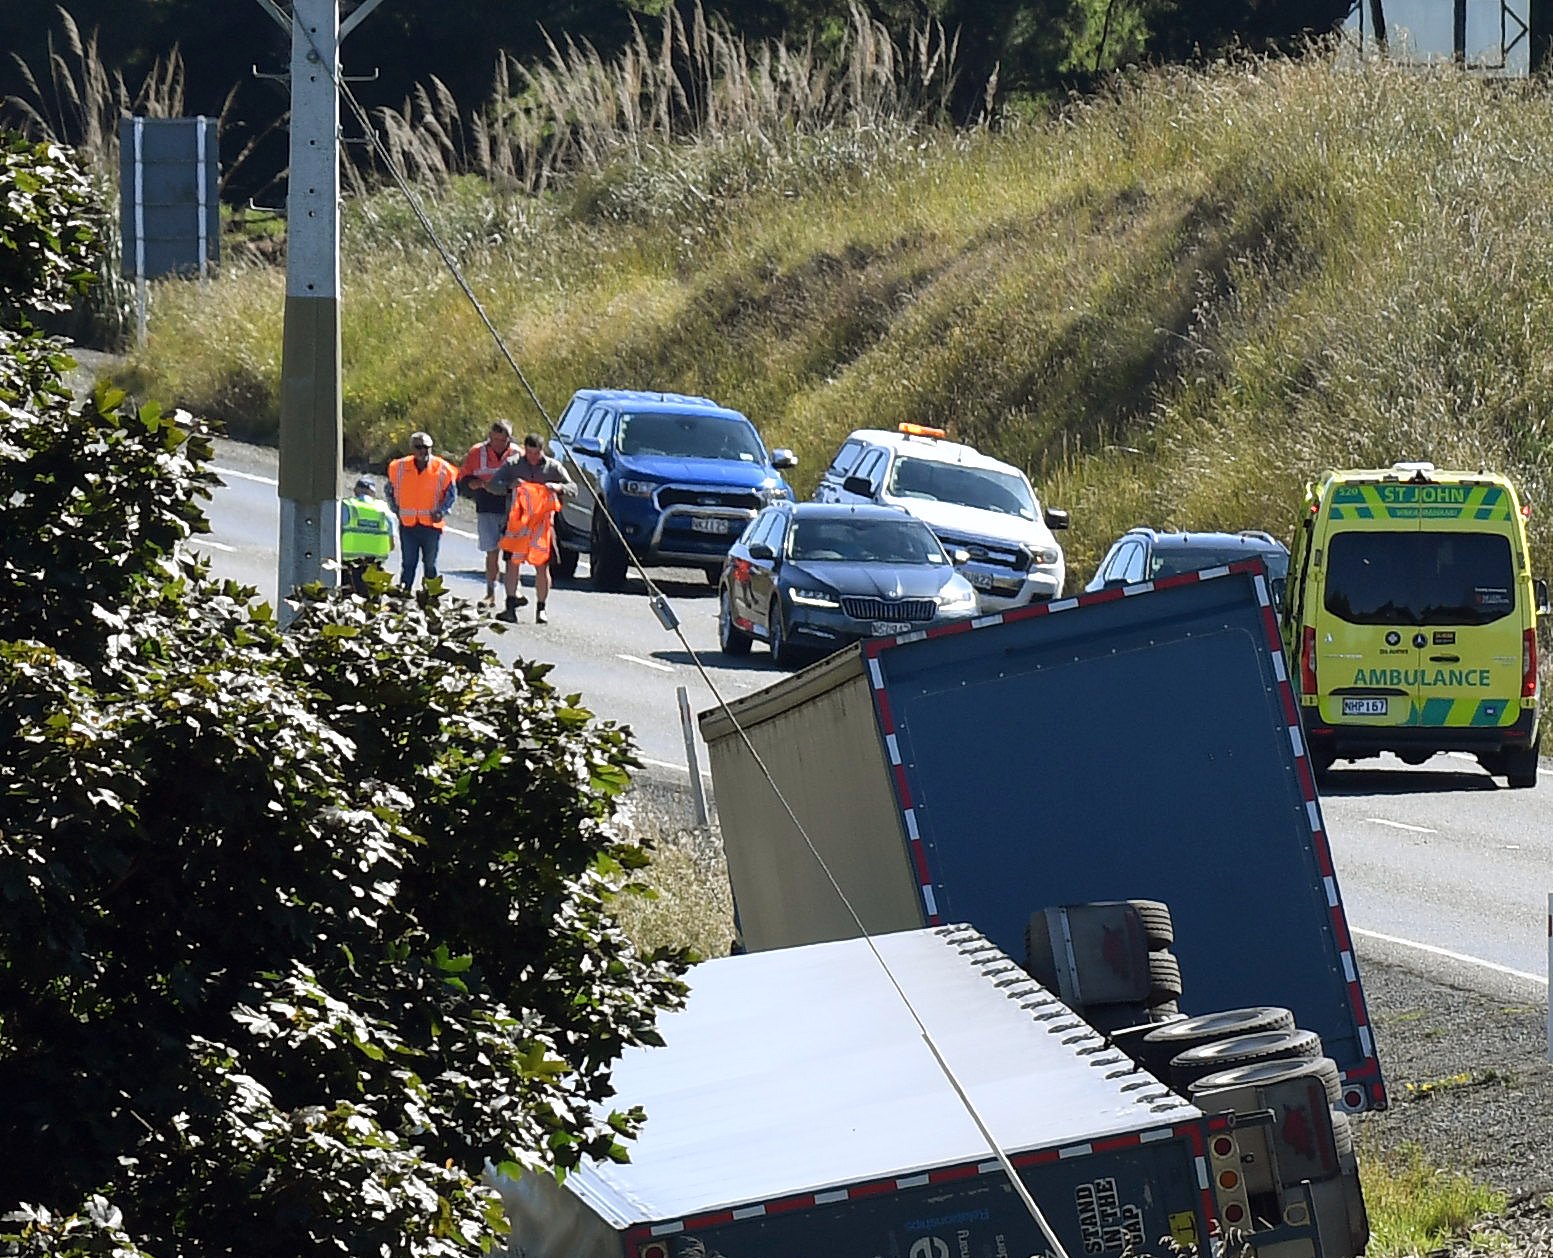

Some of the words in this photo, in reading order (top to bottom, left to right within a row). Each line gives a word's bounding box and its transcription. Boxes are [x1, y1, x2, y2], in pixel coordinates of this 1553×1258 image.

[1384, 487, 1406, 502] ST
[1414, 487, 1464, 502] JOHN
[1353, 669, 1490, 687] AMBULANCE
[1094, 1178, 1120, 1222] THE
[905, 1208, 989, 1231] Relationships
[1076, 1184, 1104, 1255] STAND
[1103, 1226, 1125, 1252] IN
